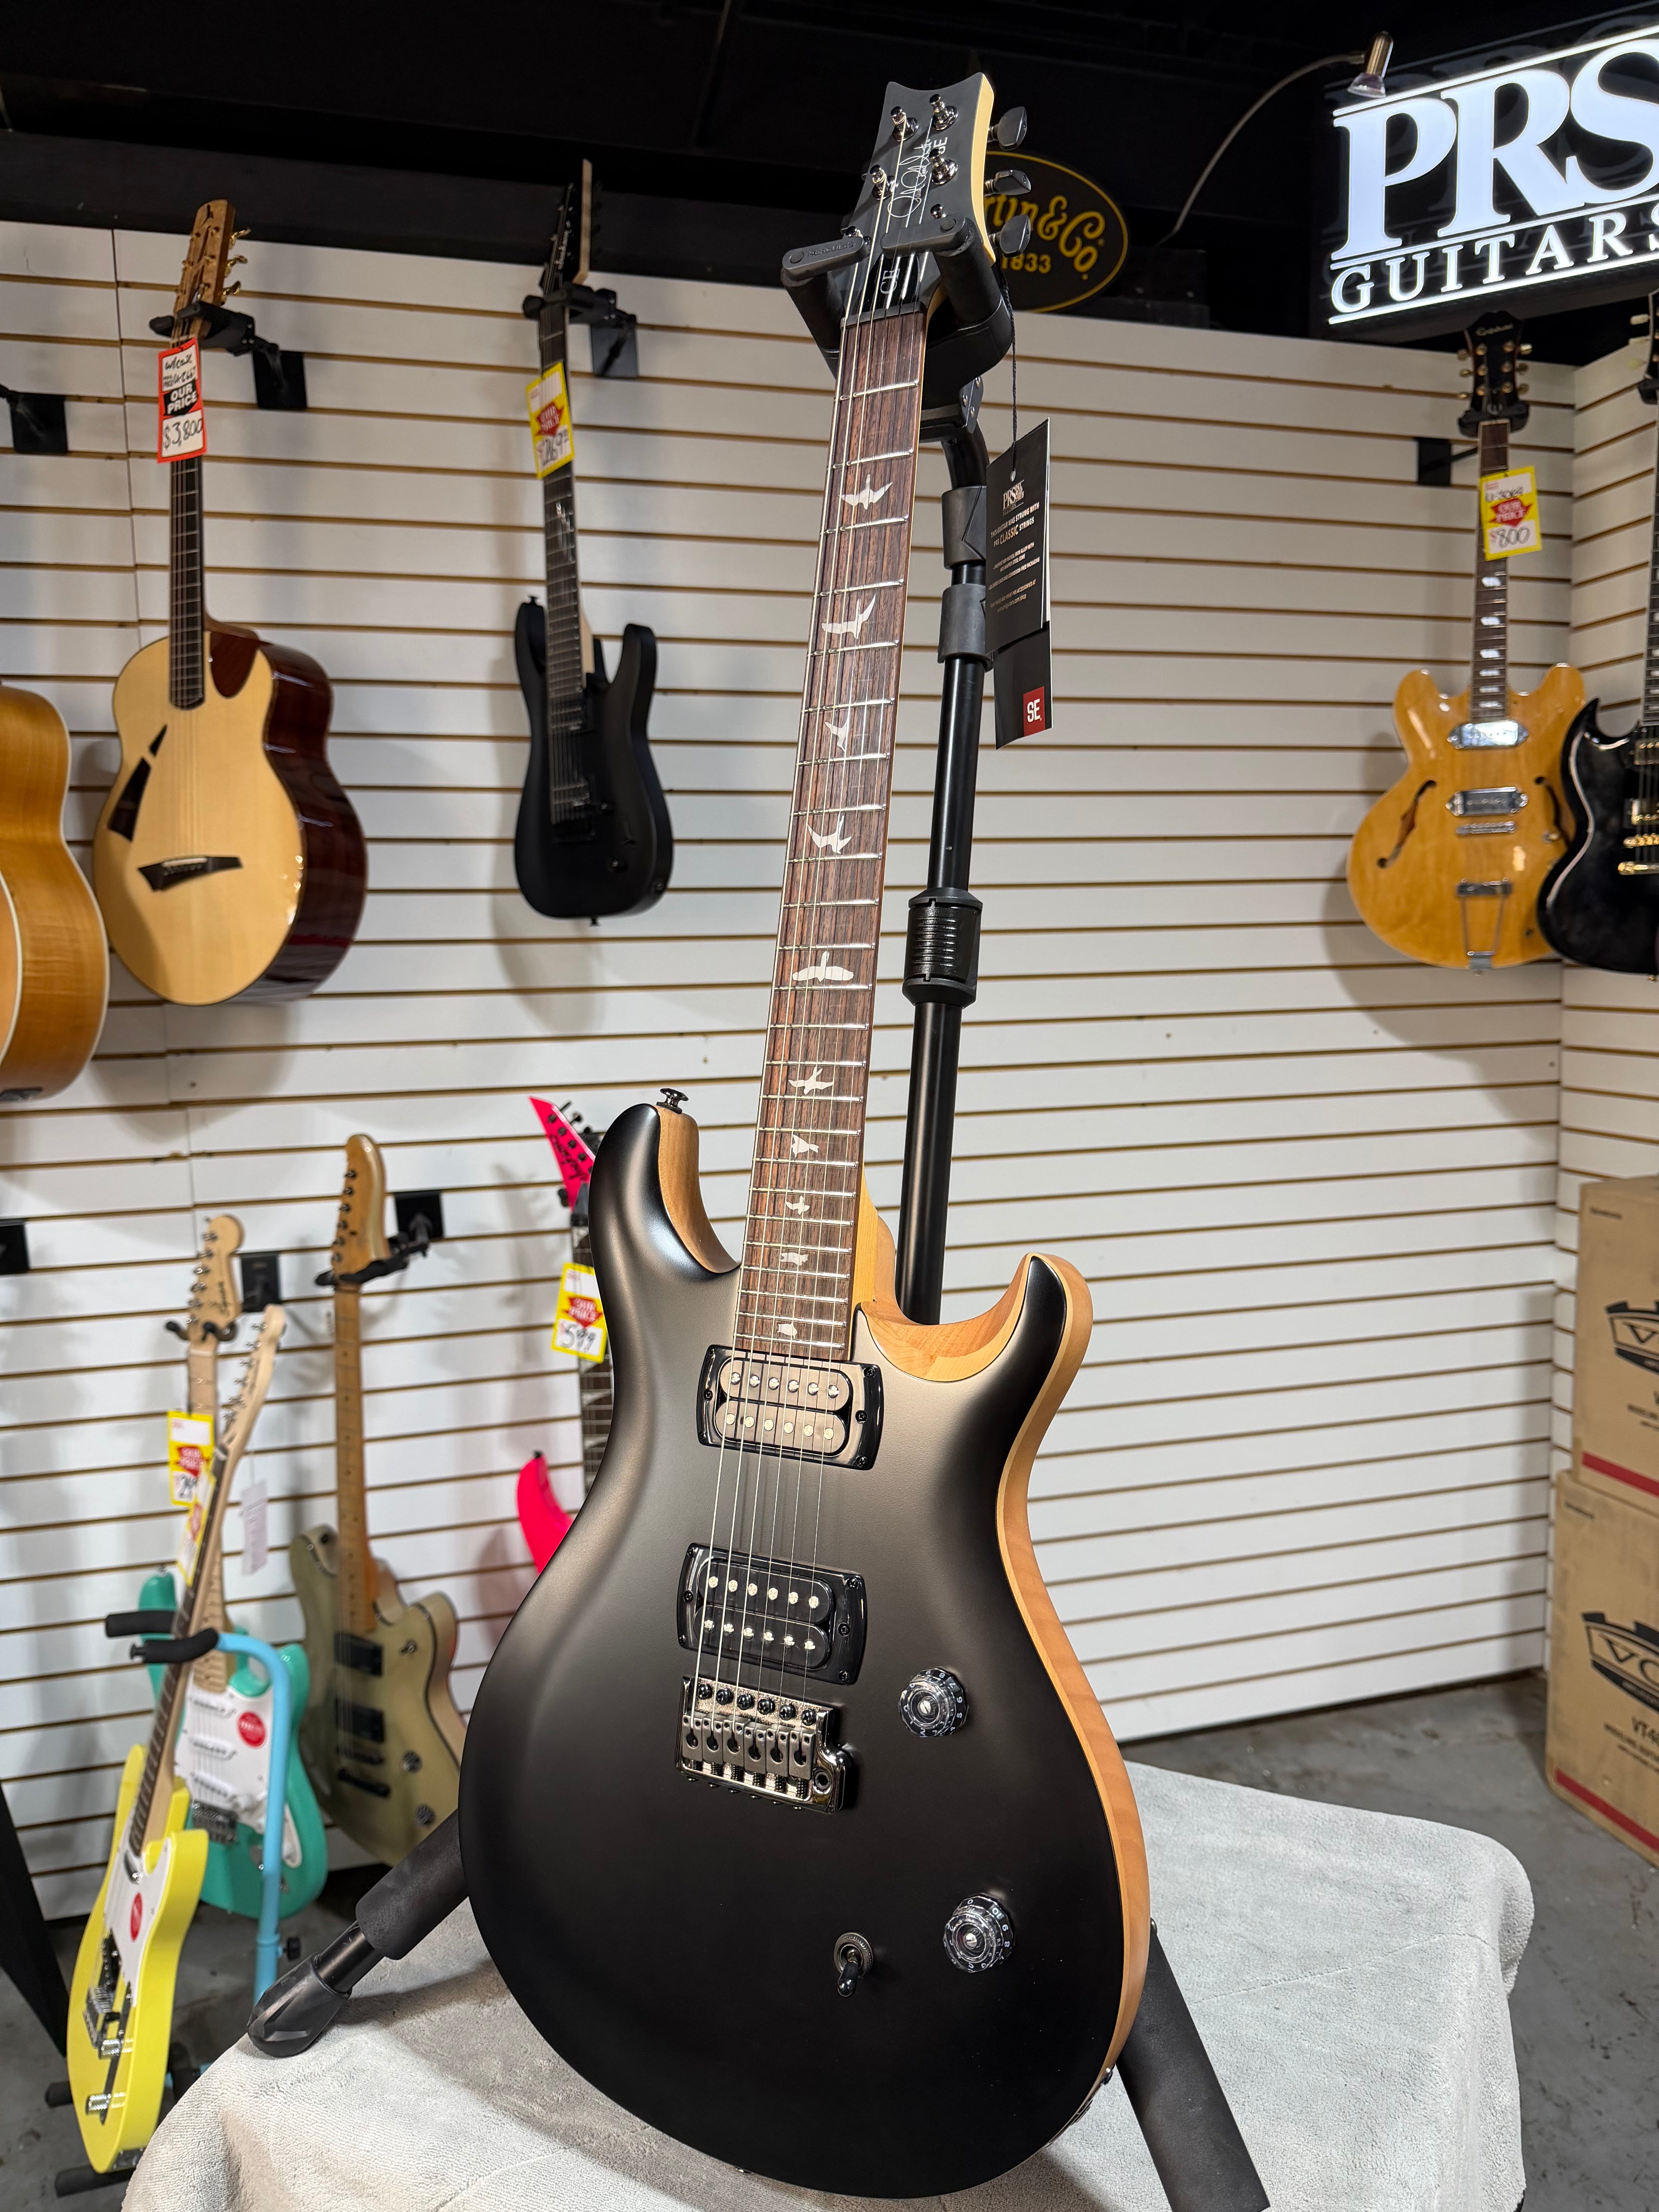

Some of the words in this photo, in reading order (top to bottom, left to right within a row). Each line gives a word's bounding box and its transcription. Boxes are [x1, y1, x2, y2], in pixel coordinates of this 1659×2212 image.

[1331, 39, 1659, 261] PRS
[1001, 252, 1051, 273] 1833
[167, 392, 198, 415] PRICE
[170, 383, 193, 402] OUR
[163, 417, 203, 450] $3,800
[1015, 508, 1029, 522] STRUNG
[1030, 501, 1039, 513] WITH
[1496, 508, 1526, 523] PRICE
[1498, 499, 1522, 514] OUR
[1000, 524, 1018, 544] CLASSIC
[1019, 516, 1034, 531] STRINGS
[1490, 527, 1530, 548] $800
[1027, 699, 1041, 722] SE
[1599, 1633, 1659, 1689] VO
